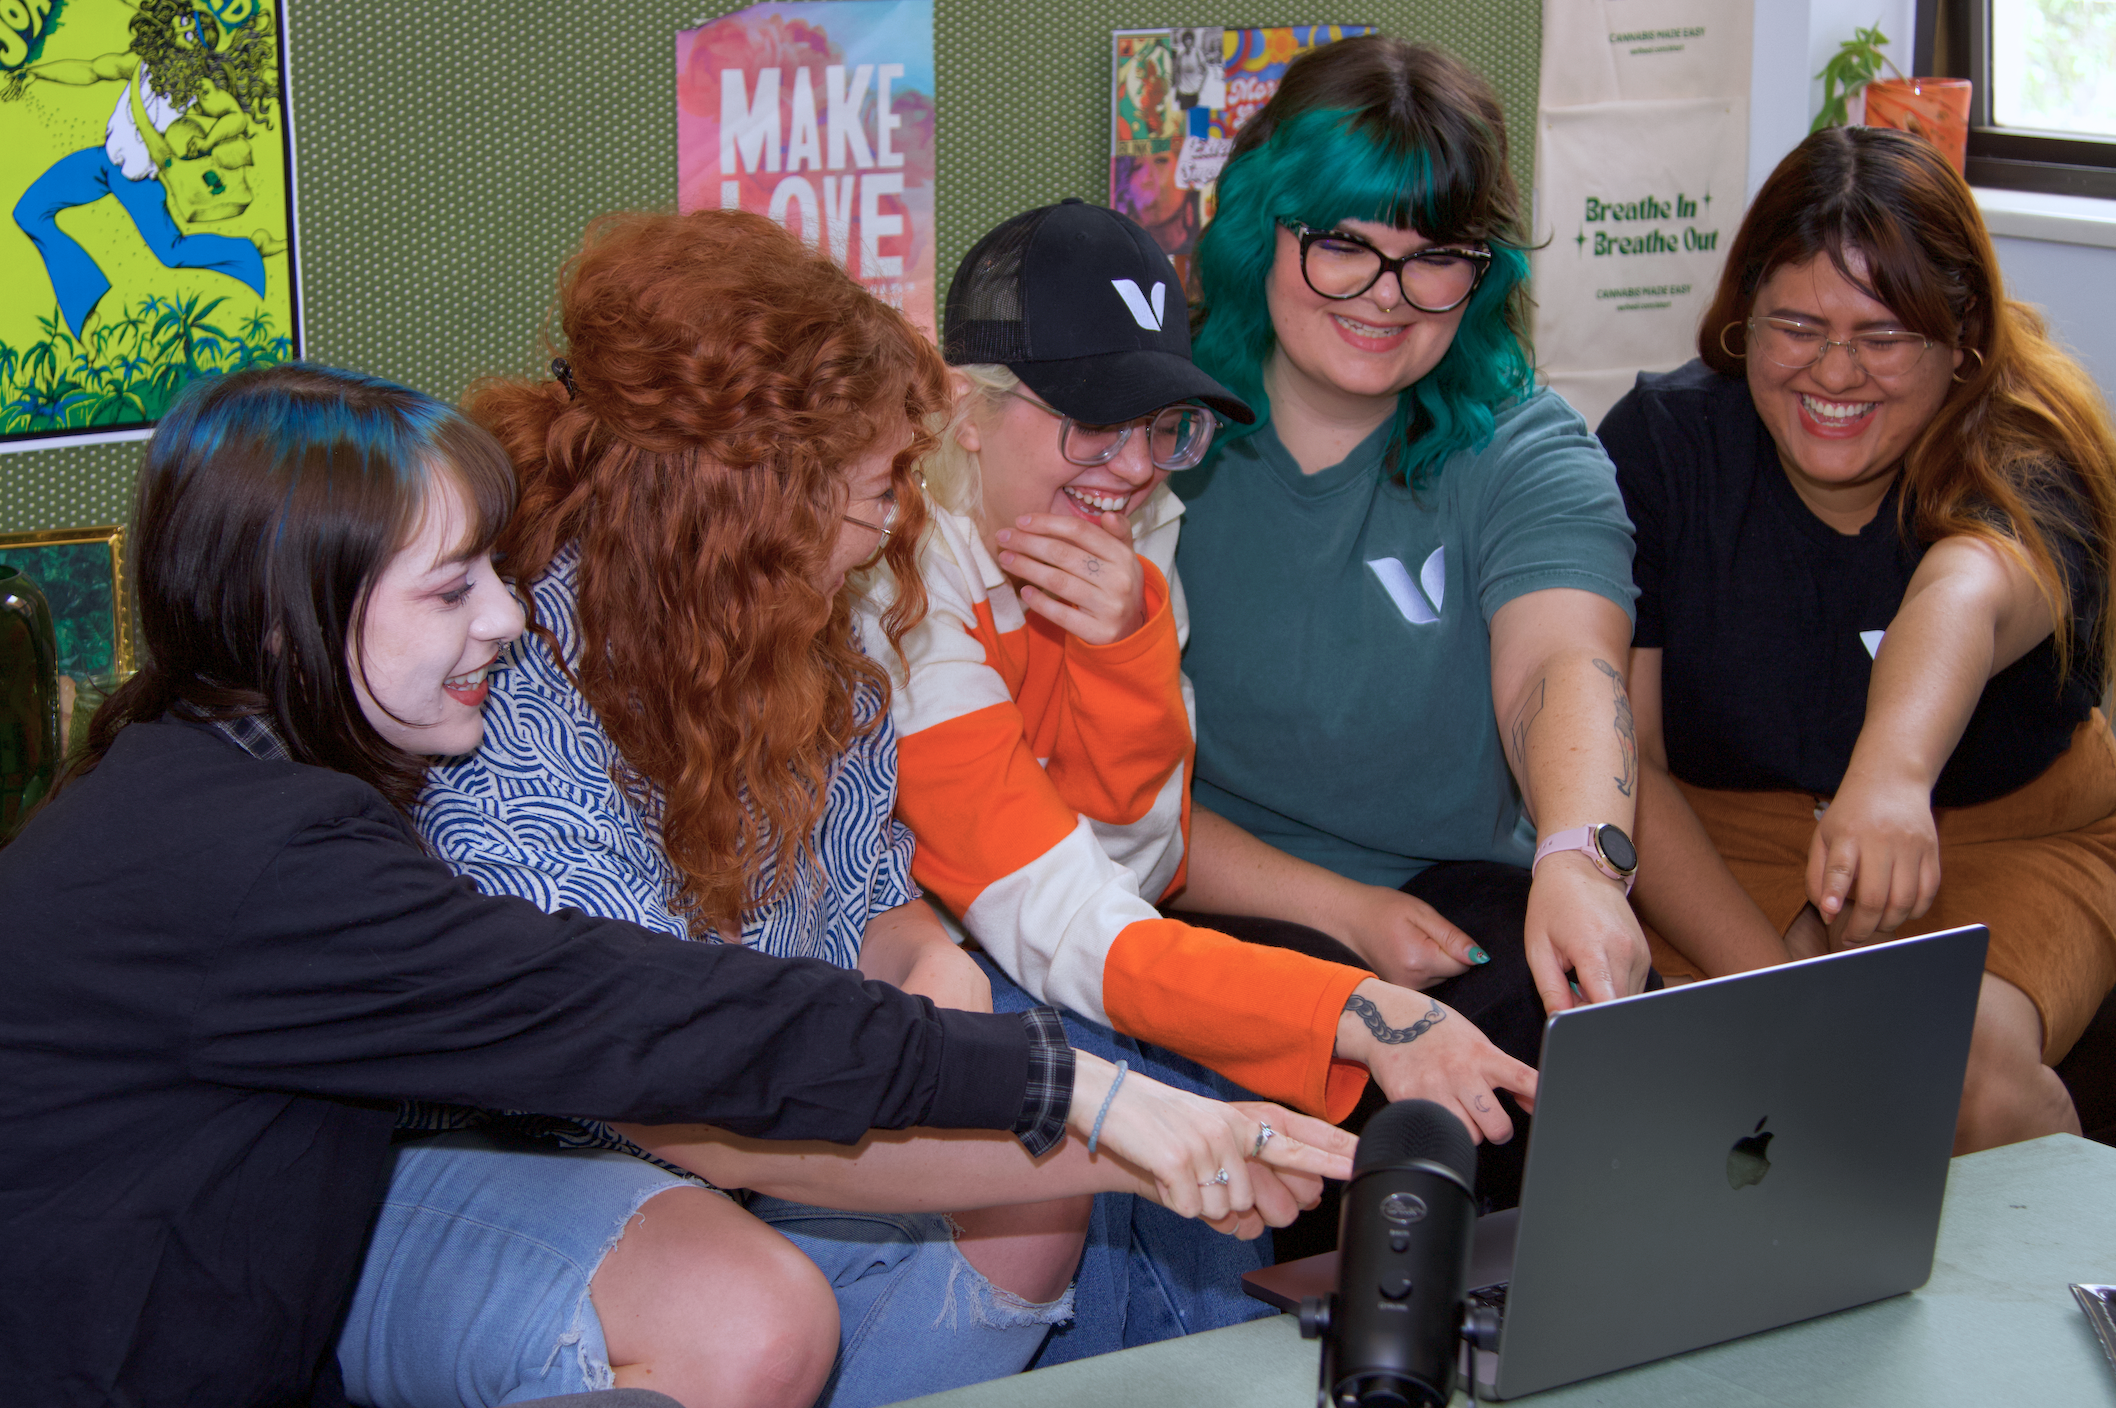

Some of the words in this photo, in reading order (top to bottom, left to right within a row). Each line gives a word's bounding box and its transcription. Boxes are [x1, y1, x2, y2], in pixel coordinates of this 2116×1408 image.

[1609, 30, 1655, 43] CANNABIS
[1657, 28, 1681, 39] MADE
[1683, 26, 1706, 37] EASY
[720, 63, 904, 175] MAKE
[1586, 195, 1672, 222] Breathe
[1677, 193, 1697, 218] In
[720, 173, 904, 278] OVE
[1594, 228, 1679, 256] Breathe
[1684, 226, 1719, 252] Out
[1597, 287, 1641, 299] CANNABIS
[1642, 285, 1668, 296] MADE
[1670, 283, 1693, 295] EASY
